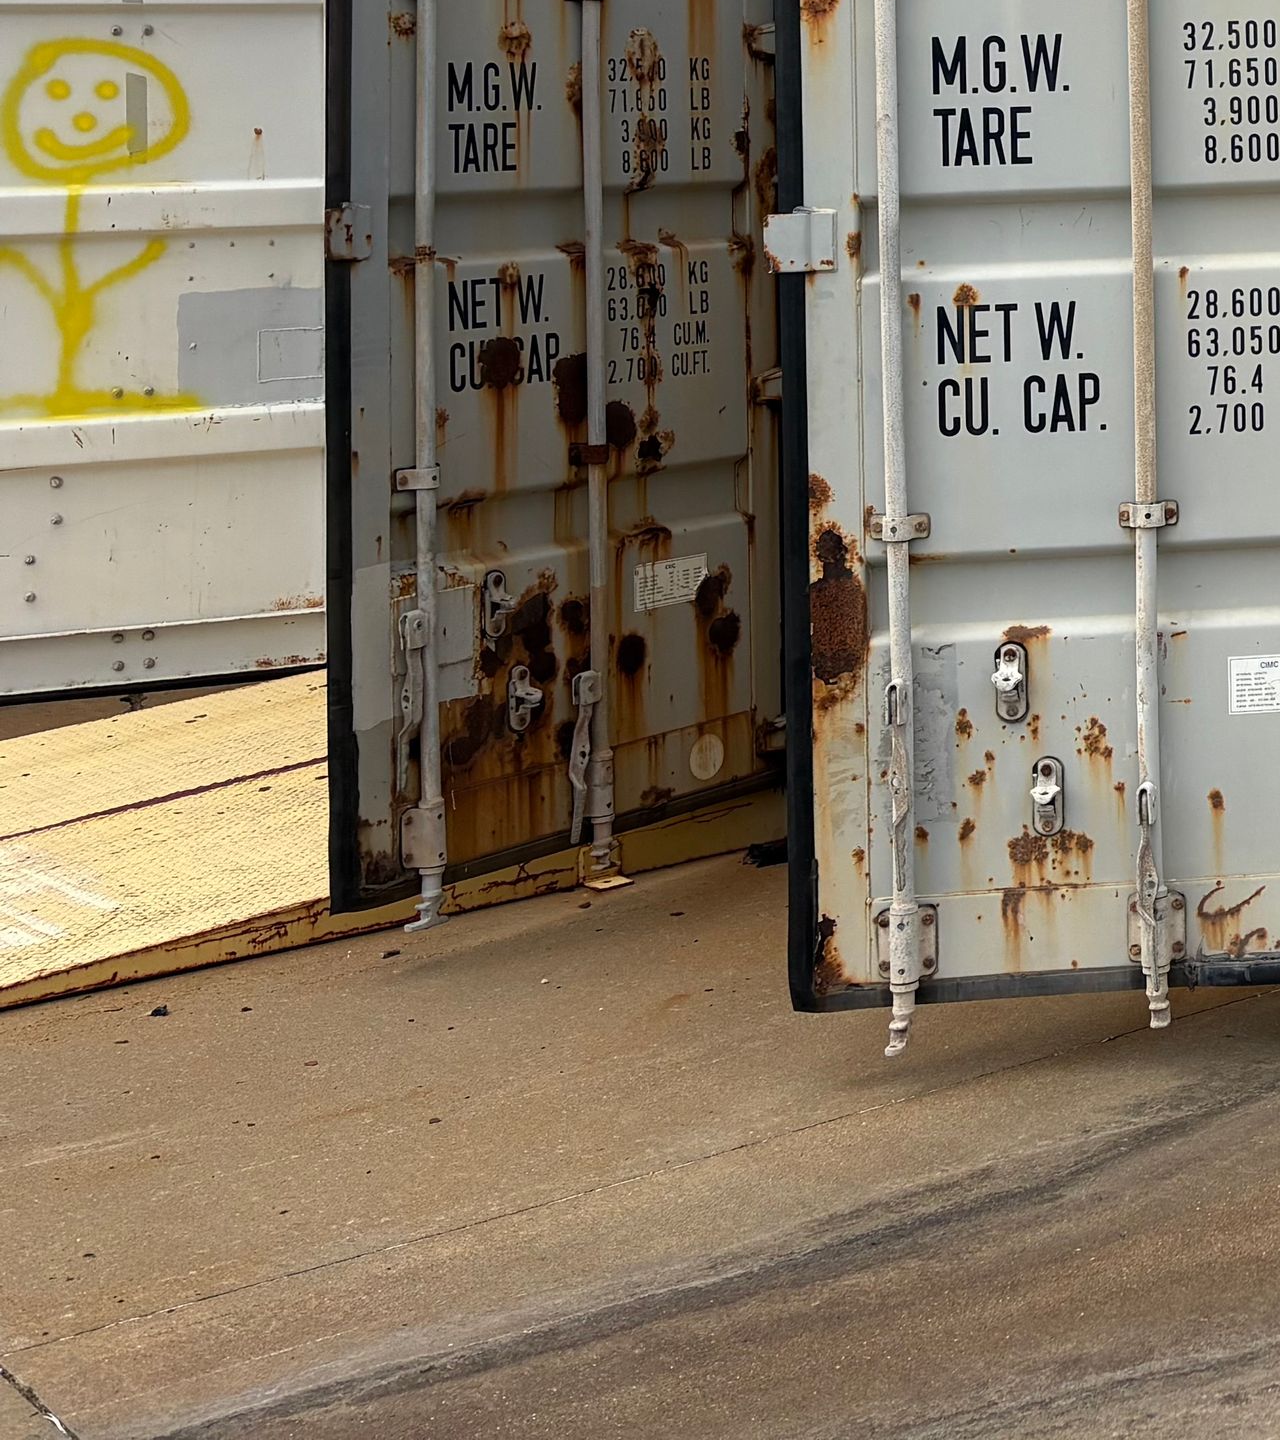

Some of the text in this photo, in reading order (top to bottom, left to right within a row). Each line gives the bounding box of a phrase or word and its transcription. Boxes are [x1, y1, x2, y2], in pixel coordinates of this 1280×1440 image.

[1182, 19, 1277, 52] 32,500
[688, 57, 710, 82] KG
[931, 33, 1070, 95] M.G.W.
[1184, 57, 1278, 90] 71,650
[447, 61, 542, 113] M.G.W.
[689, 86, 711, 112] LB
[1203, 94, 1279, 127] 3,900
[690, 116, 712, 142] KG
[932, 106, 1034, 167] TARE
[447, 122, 518, 174] TARE
[691, 146, 712, 171] LB
[1204, 132, 1280, 164] 8,600
[688, 260, 709, 285] KG
[447, 273, 550, 332] NET W.
[608, 290, 710, 322] 63,00 LB
[1186, 286, 1280, 320] 28,600
[673, 320, 711, 347] CU.M.
[936, 300, 1084, 365] NET W.
[671, 350, 711, 377] CU.FT.
[1206, 363, 1264, 396] 76.4
[937, 372, 1108, 437] CU. CAP.
[1188, 402, 1265, 435] 2,700
